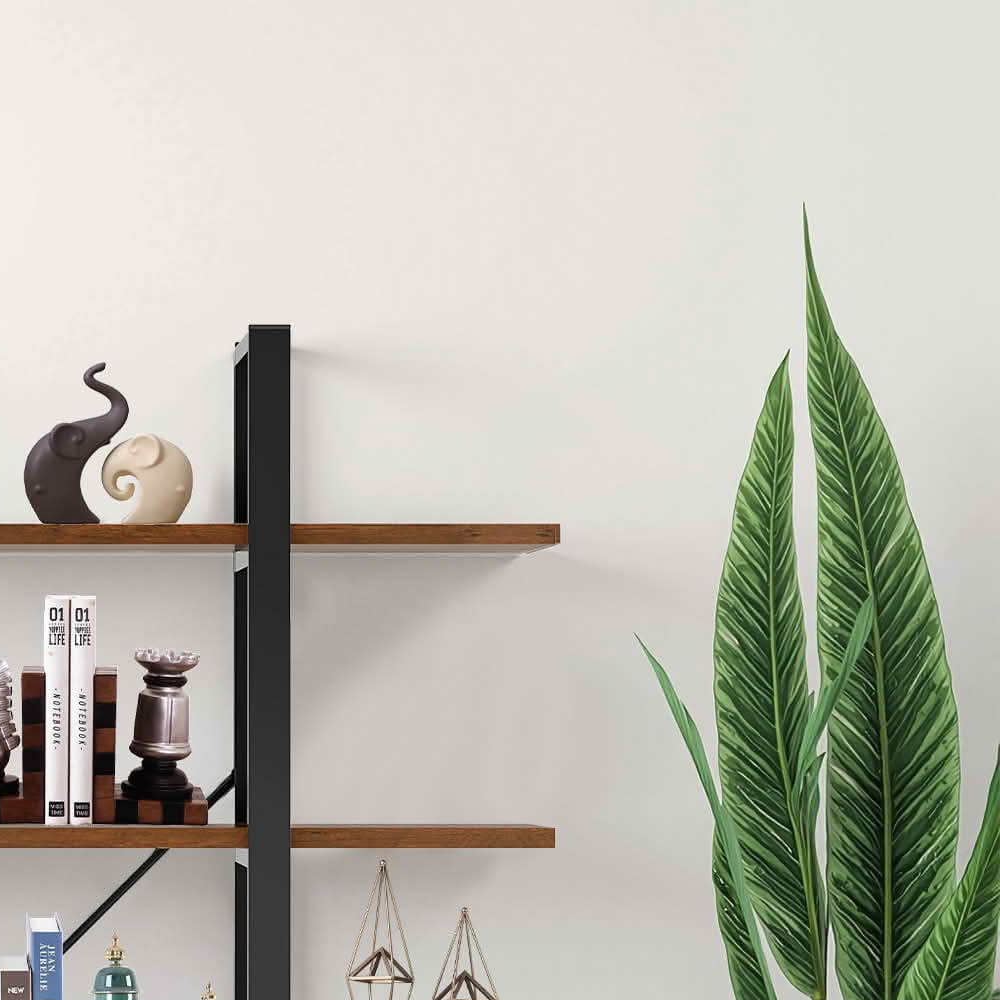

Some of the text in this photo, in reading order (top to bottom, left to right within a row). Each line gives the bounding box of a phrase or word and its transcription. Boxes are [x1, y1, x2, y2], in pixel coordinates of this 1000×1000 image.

[49, 607, 64, 621] 01
[75, 607, 90, 622] 01
[48, 634, 65, 646] LIFE
[74, 634, 91, 646] LIFE
[47, 944, 56, 973] JEAN
[39, 943, 48, 992] AURELIE
[8, 986, 24, 995] NEW
